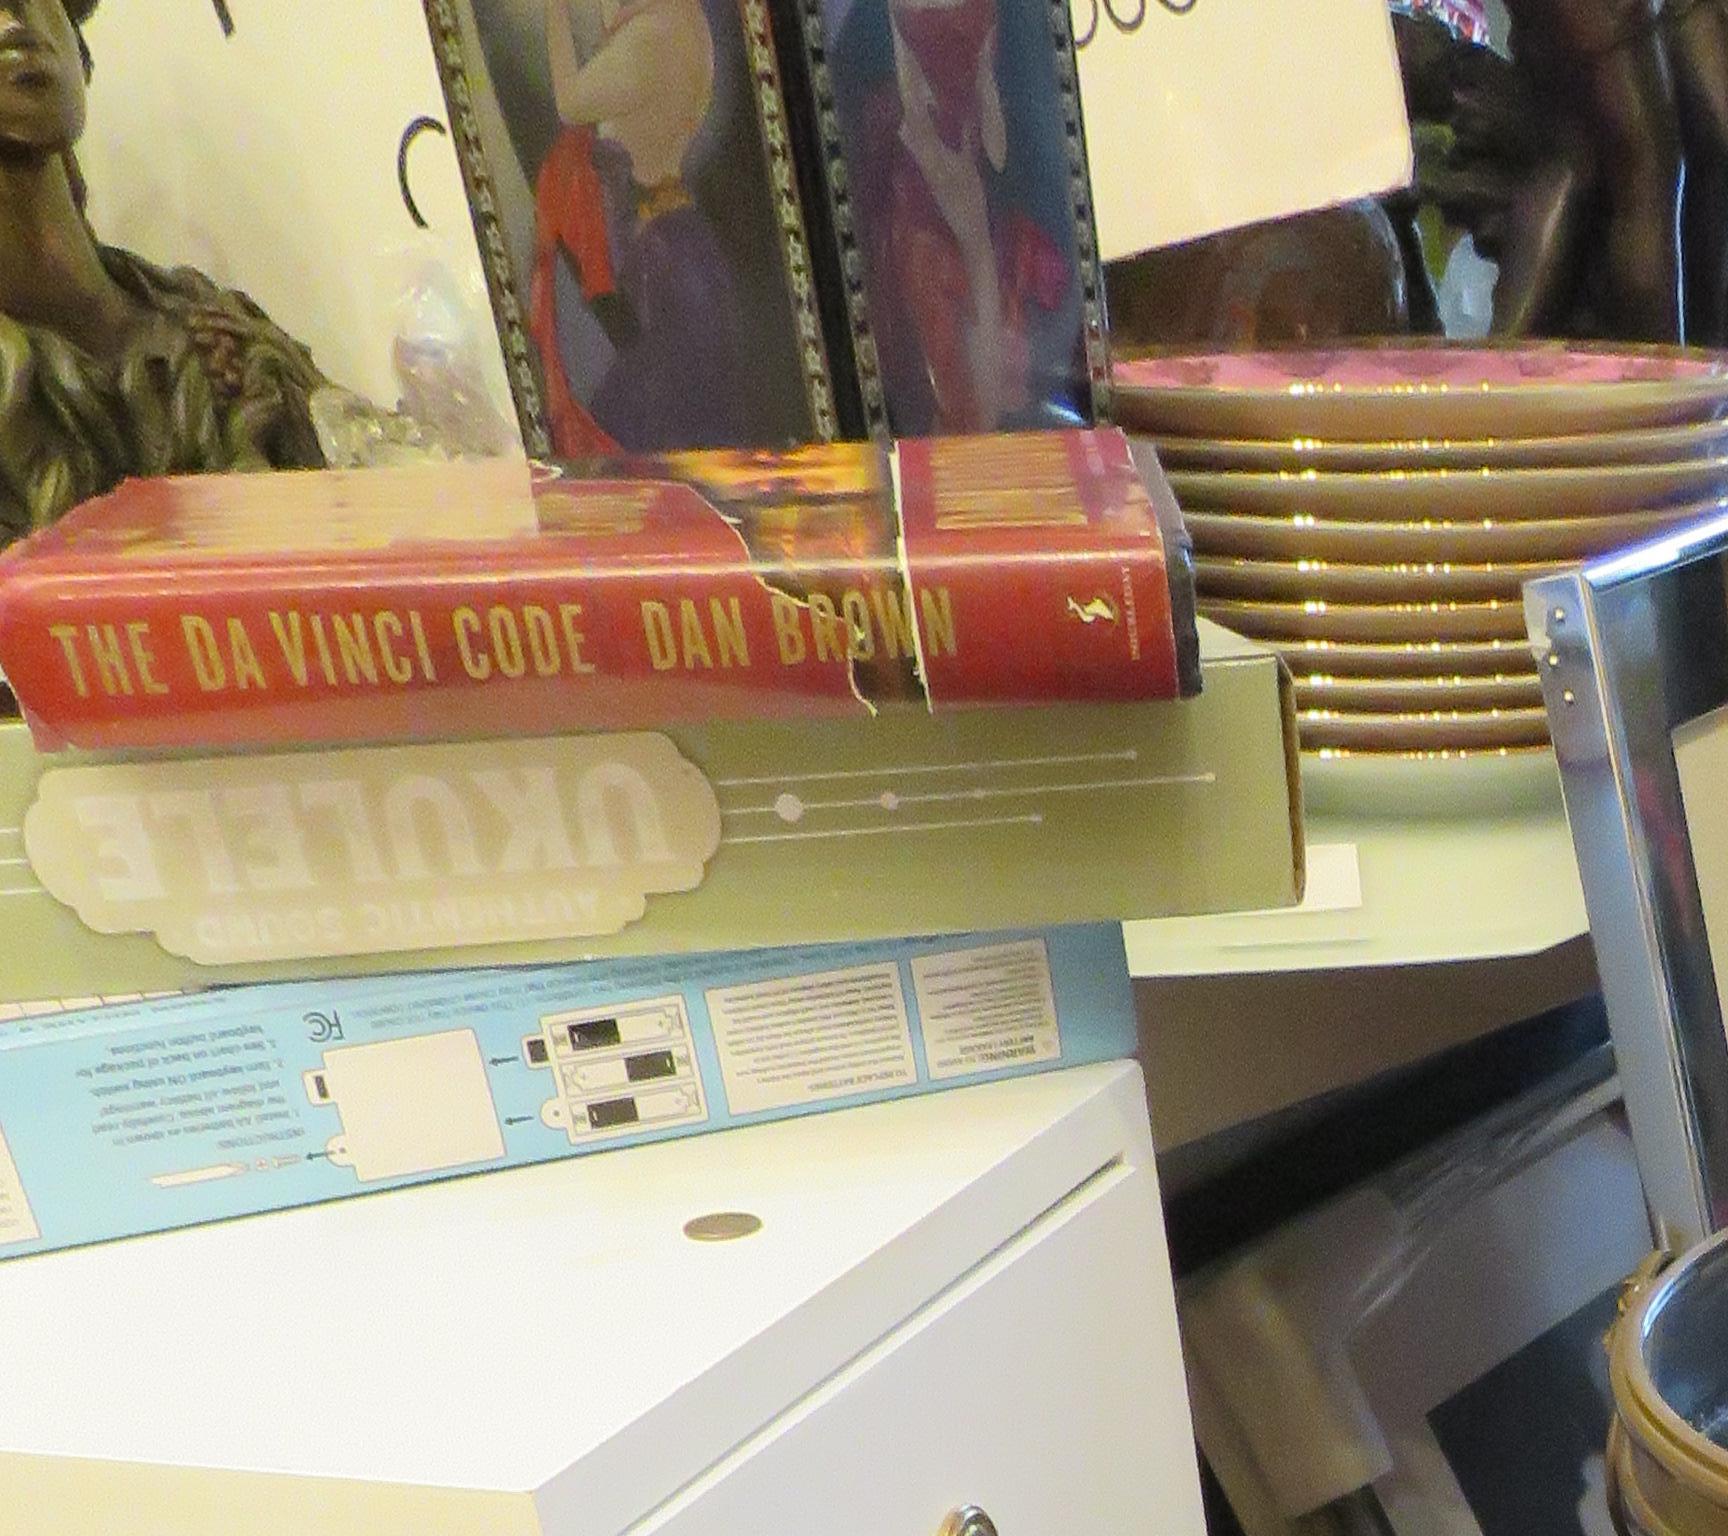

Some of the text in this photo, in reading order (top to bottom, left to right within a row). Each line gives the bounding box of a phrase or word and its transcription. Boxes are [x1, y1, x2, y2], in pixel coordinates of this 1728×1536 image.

[49, 587, 958, 698] THE DA VINCI CODE DAN BROWN
[73, 761, 680, 903] UKULELE
[197, 893, 600, 947] AUTHENTIC SOUND
